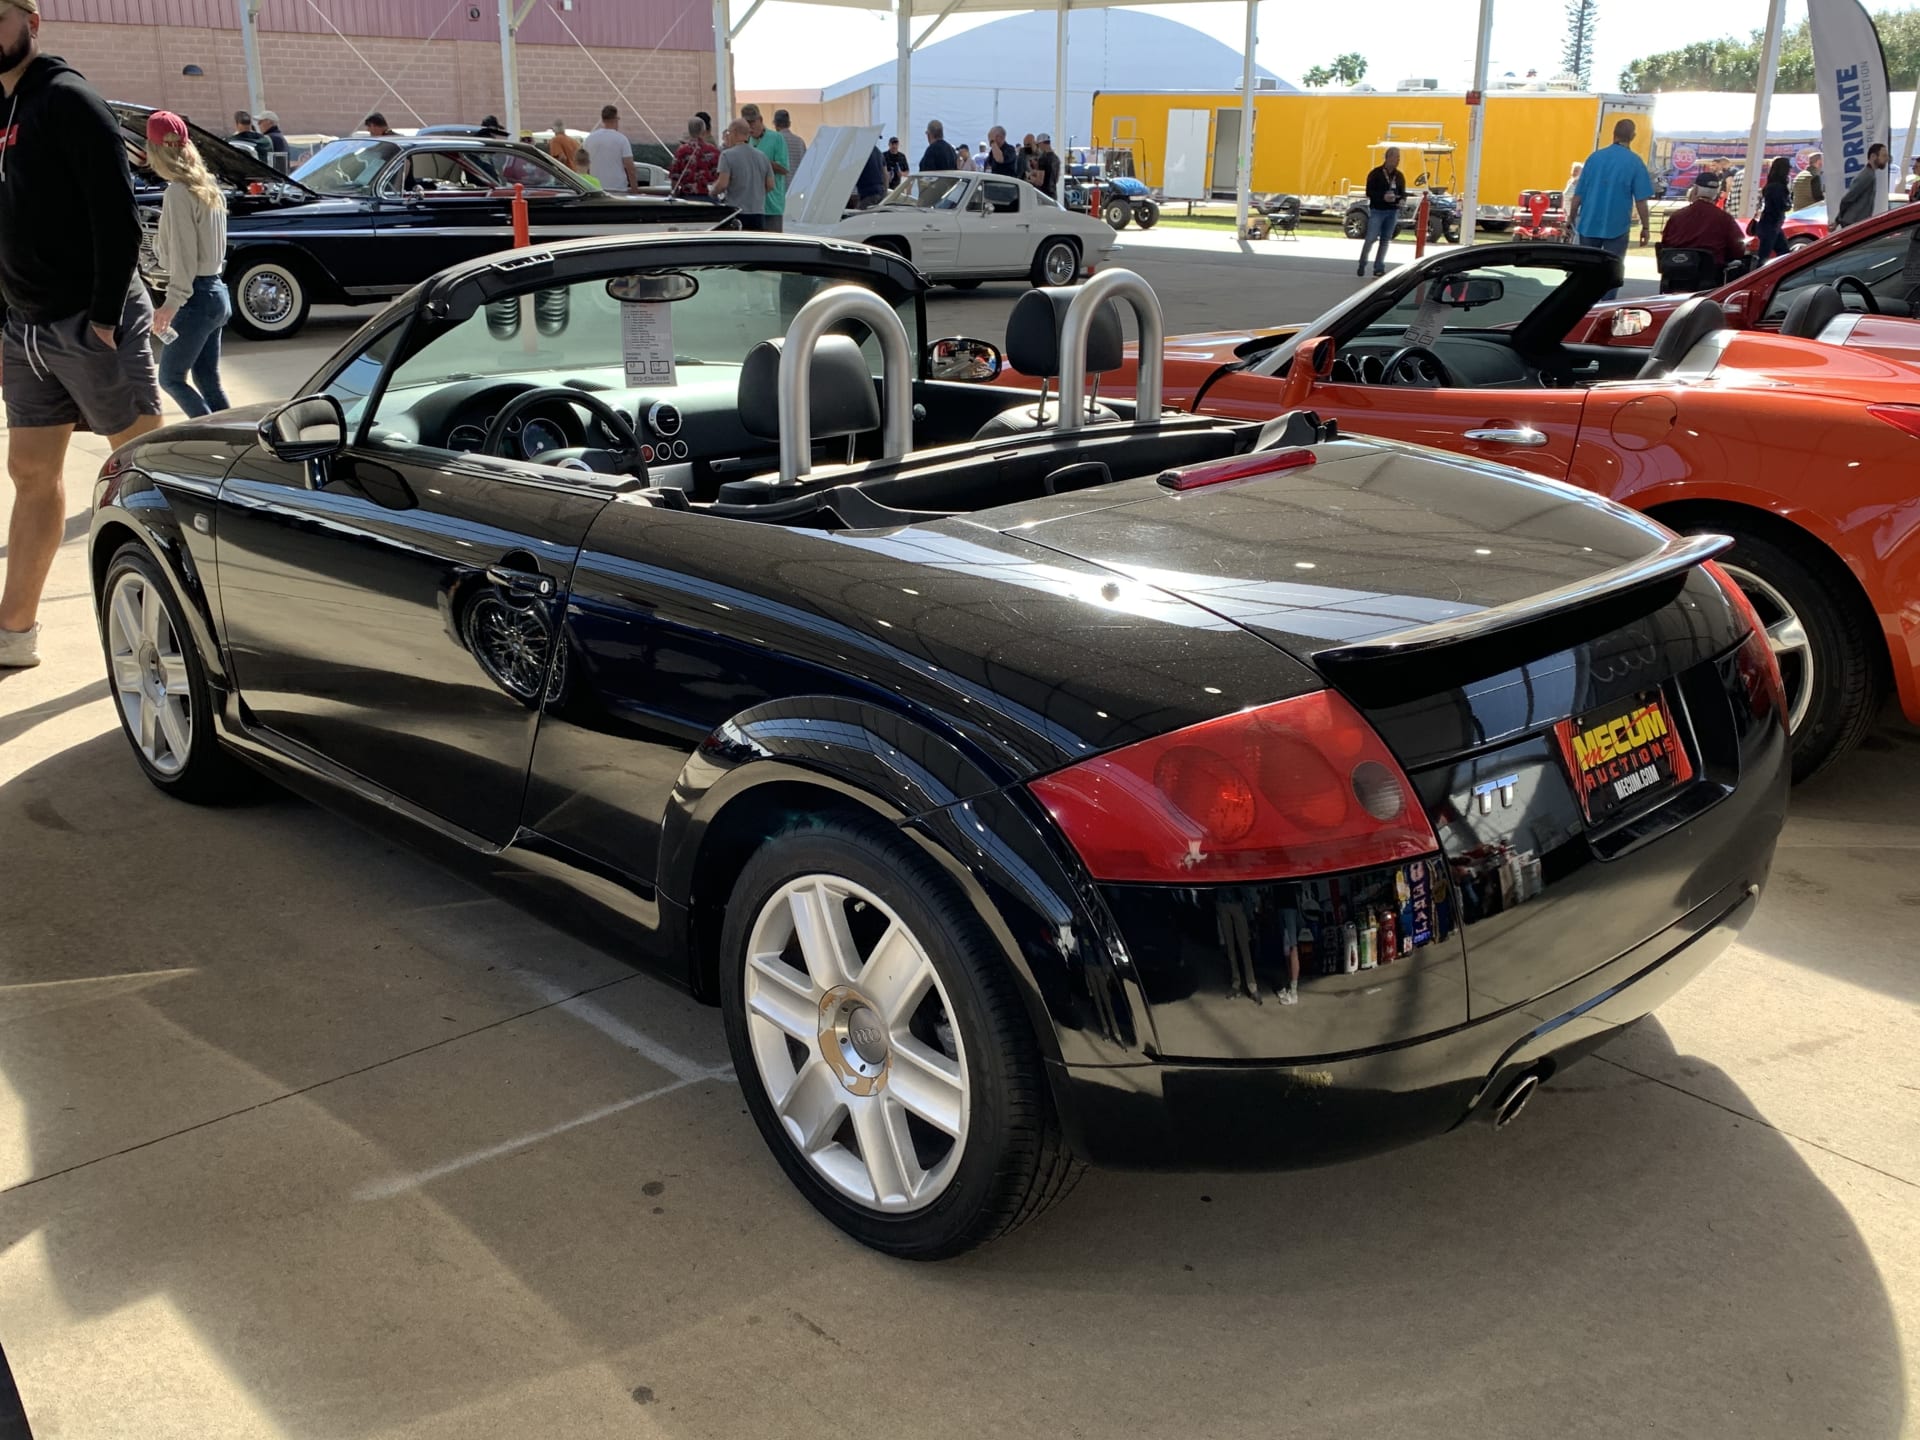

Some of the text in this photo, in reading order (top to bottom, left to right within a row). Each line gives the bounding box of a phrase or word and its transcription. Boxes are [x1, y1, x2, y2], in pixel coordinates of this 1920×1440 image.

[1860, 60, 1874, 121] COLLECTION
[1674, 153, 1693, 163] 303
[1572, 702, 1668, 771] MECUM
[1584, 737, 1676, 791] AUCTIONS
[1613, 764, 1660, 800] MECUM.COM
[1473, 772, 1519, 813] TT
